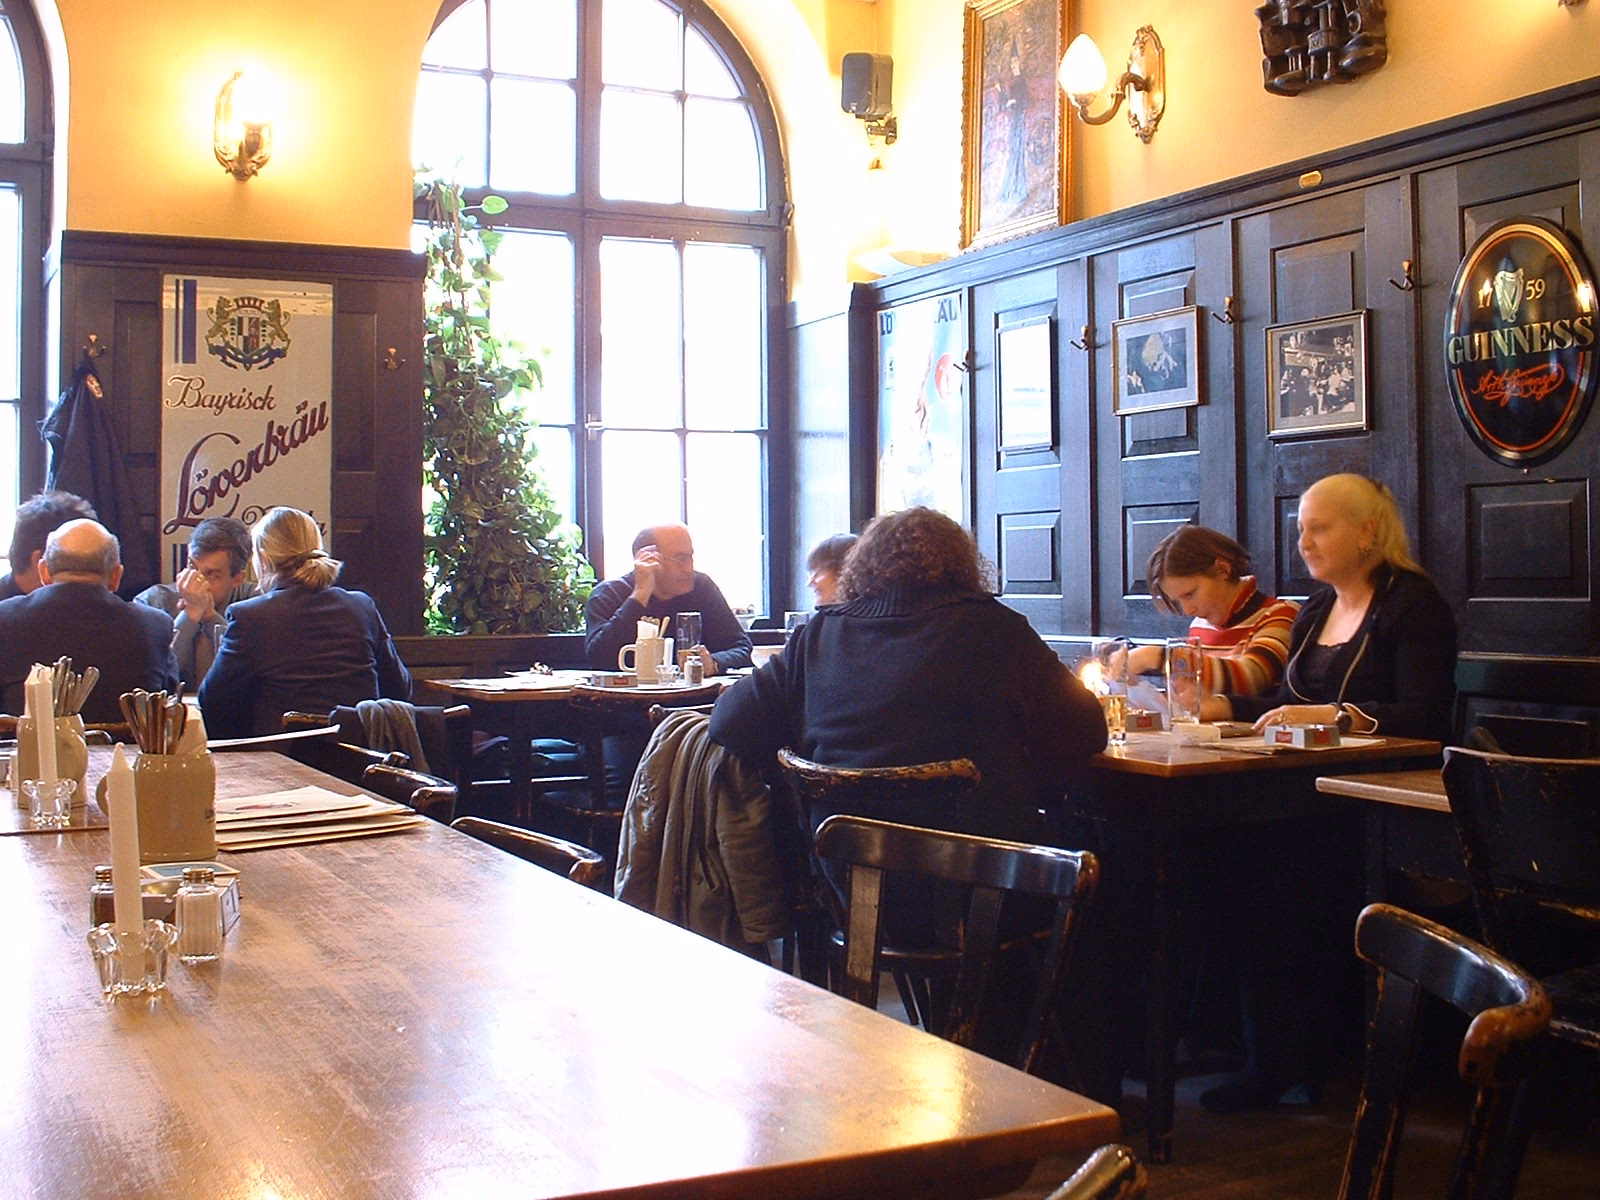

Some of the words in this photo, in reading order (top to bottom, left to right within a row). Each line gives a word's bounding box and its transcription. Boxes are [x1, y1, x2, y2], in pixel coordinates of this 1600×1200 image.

[1525, 279, 1545, 300] 59
[1448, 316, 1594, 365] GUINNESS
[163, 400, 329, 535] Löwenbräu
